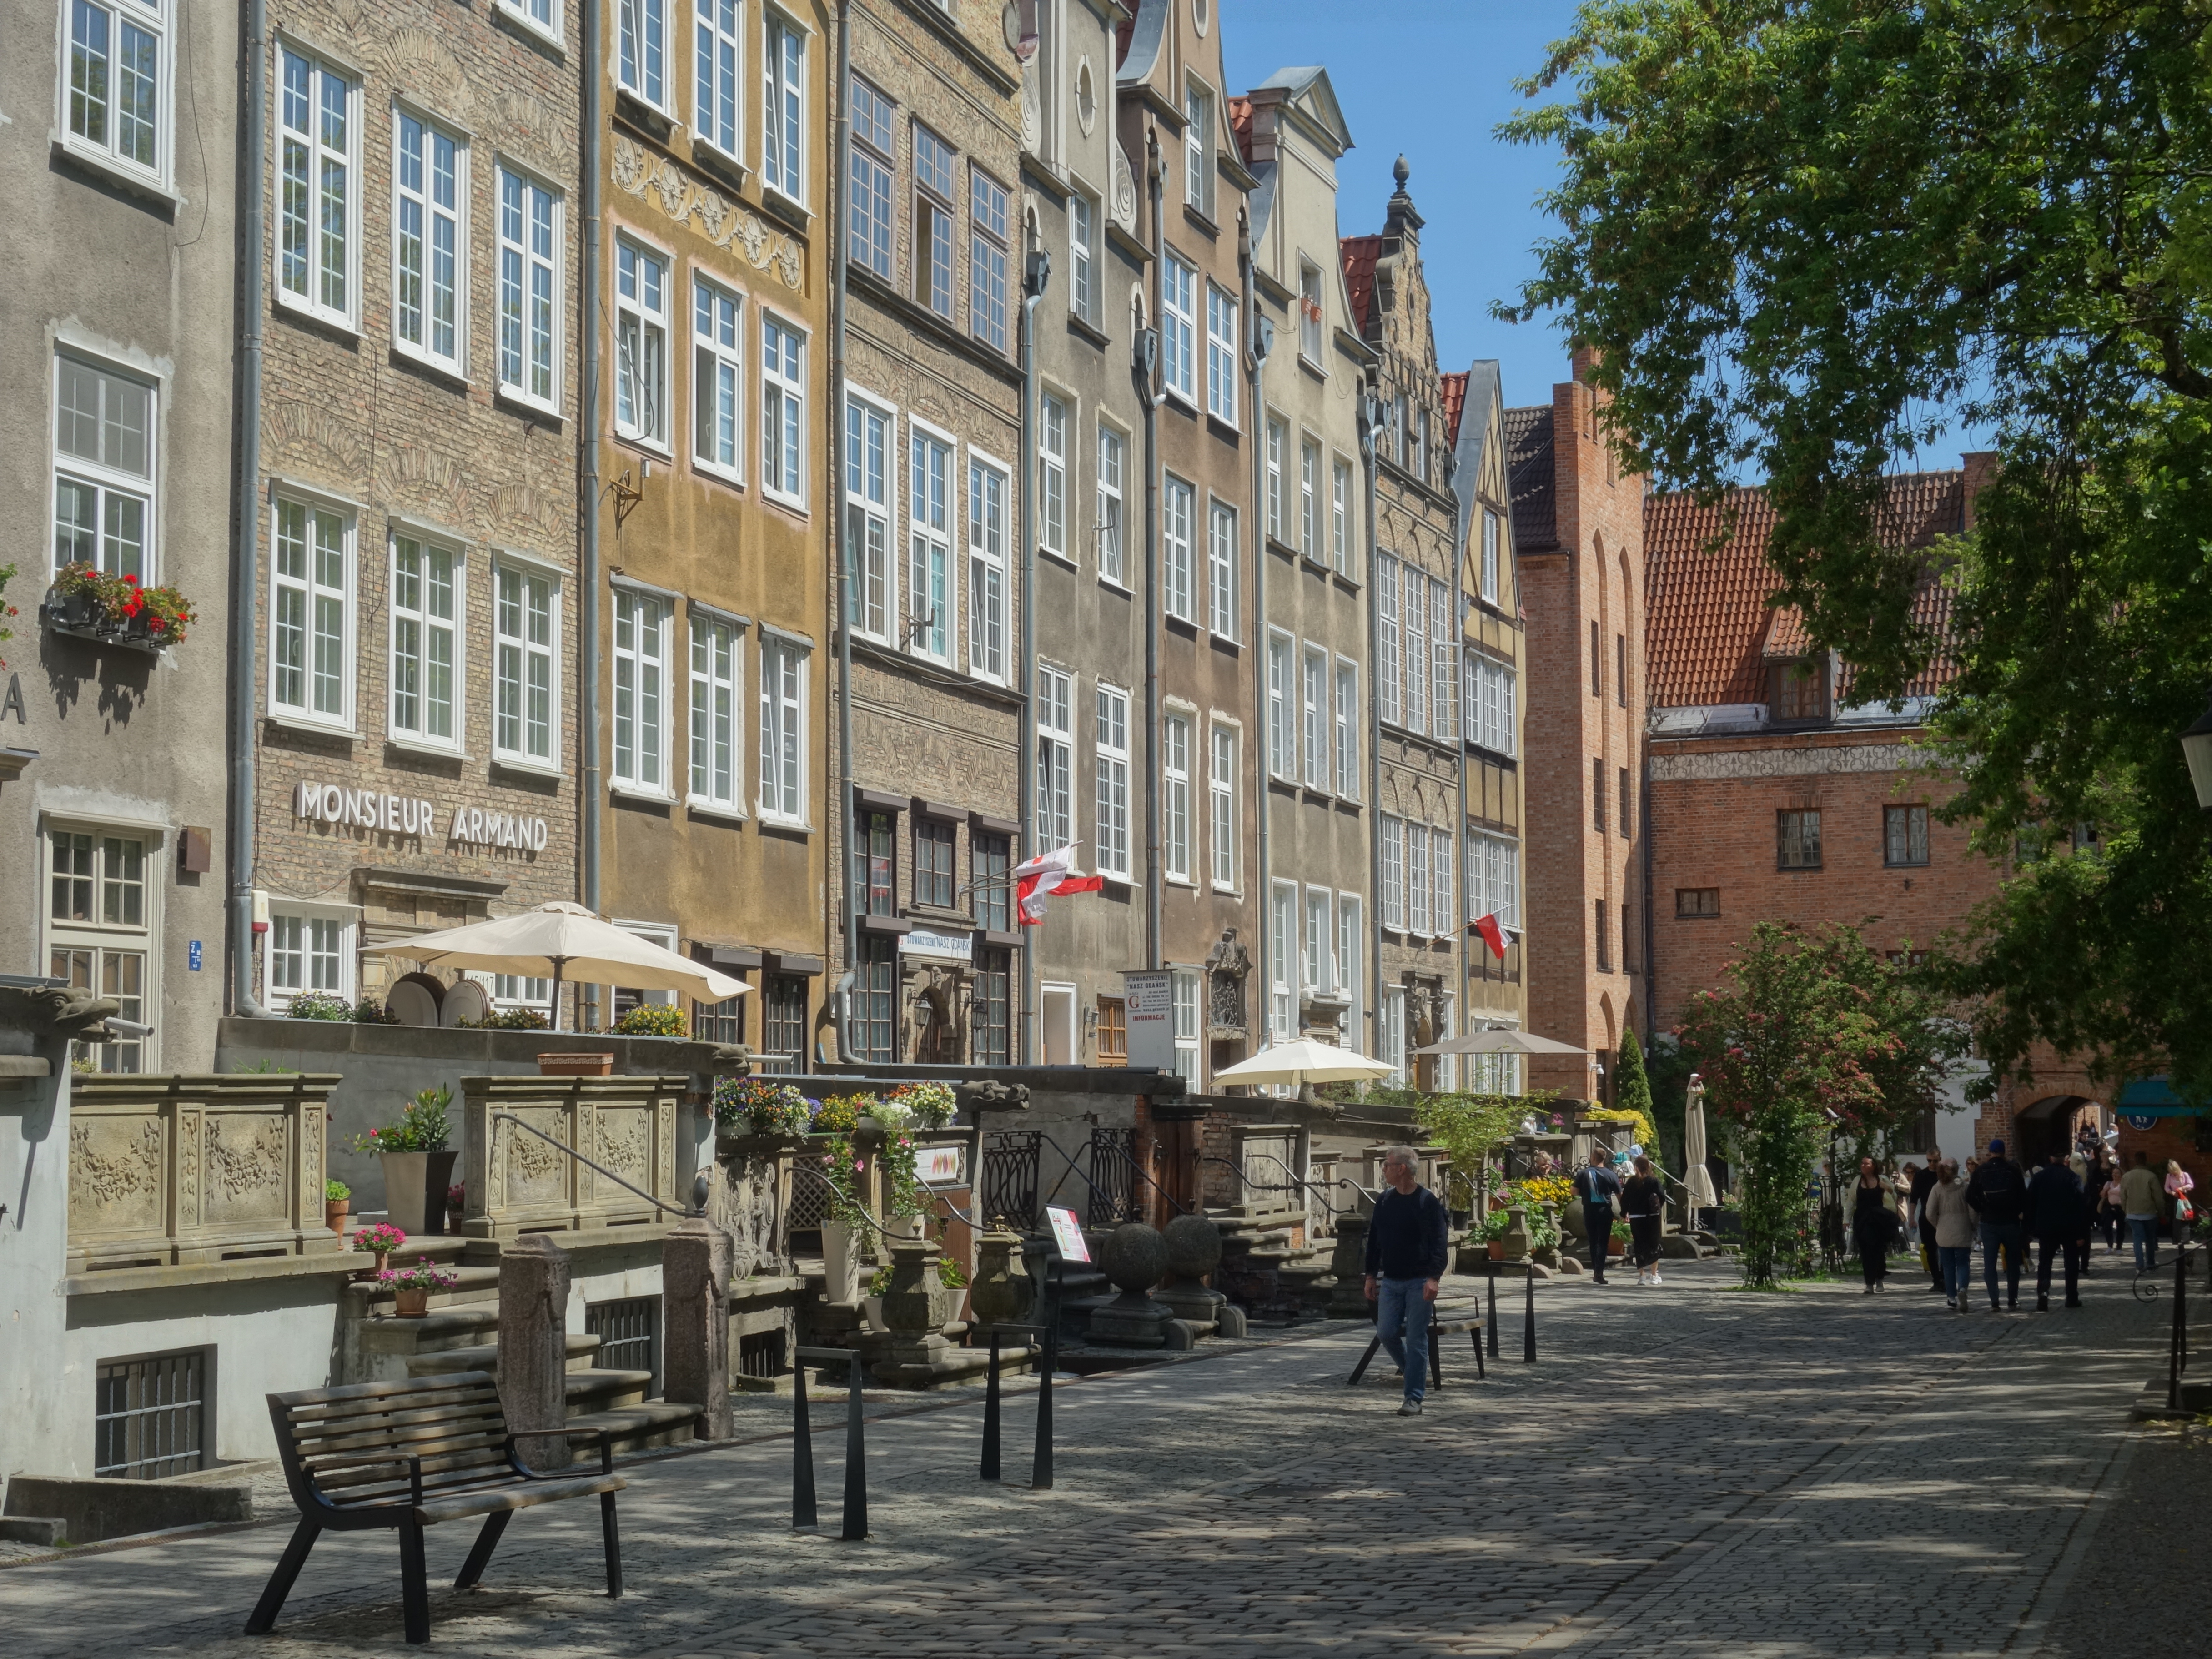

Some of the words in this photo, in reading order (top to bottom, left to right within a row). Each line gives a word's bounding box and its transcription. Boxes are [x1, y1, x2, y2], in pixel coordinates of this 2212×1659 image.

[1, 672, 27, 725] A
[296, 780, 434, 836] MONSIEUR
[450, 806, 547, 851] ARMAND
[907, 935, 935, 947] STOWARZYSZENIE
[1128, 995, 1141, 1009] G
